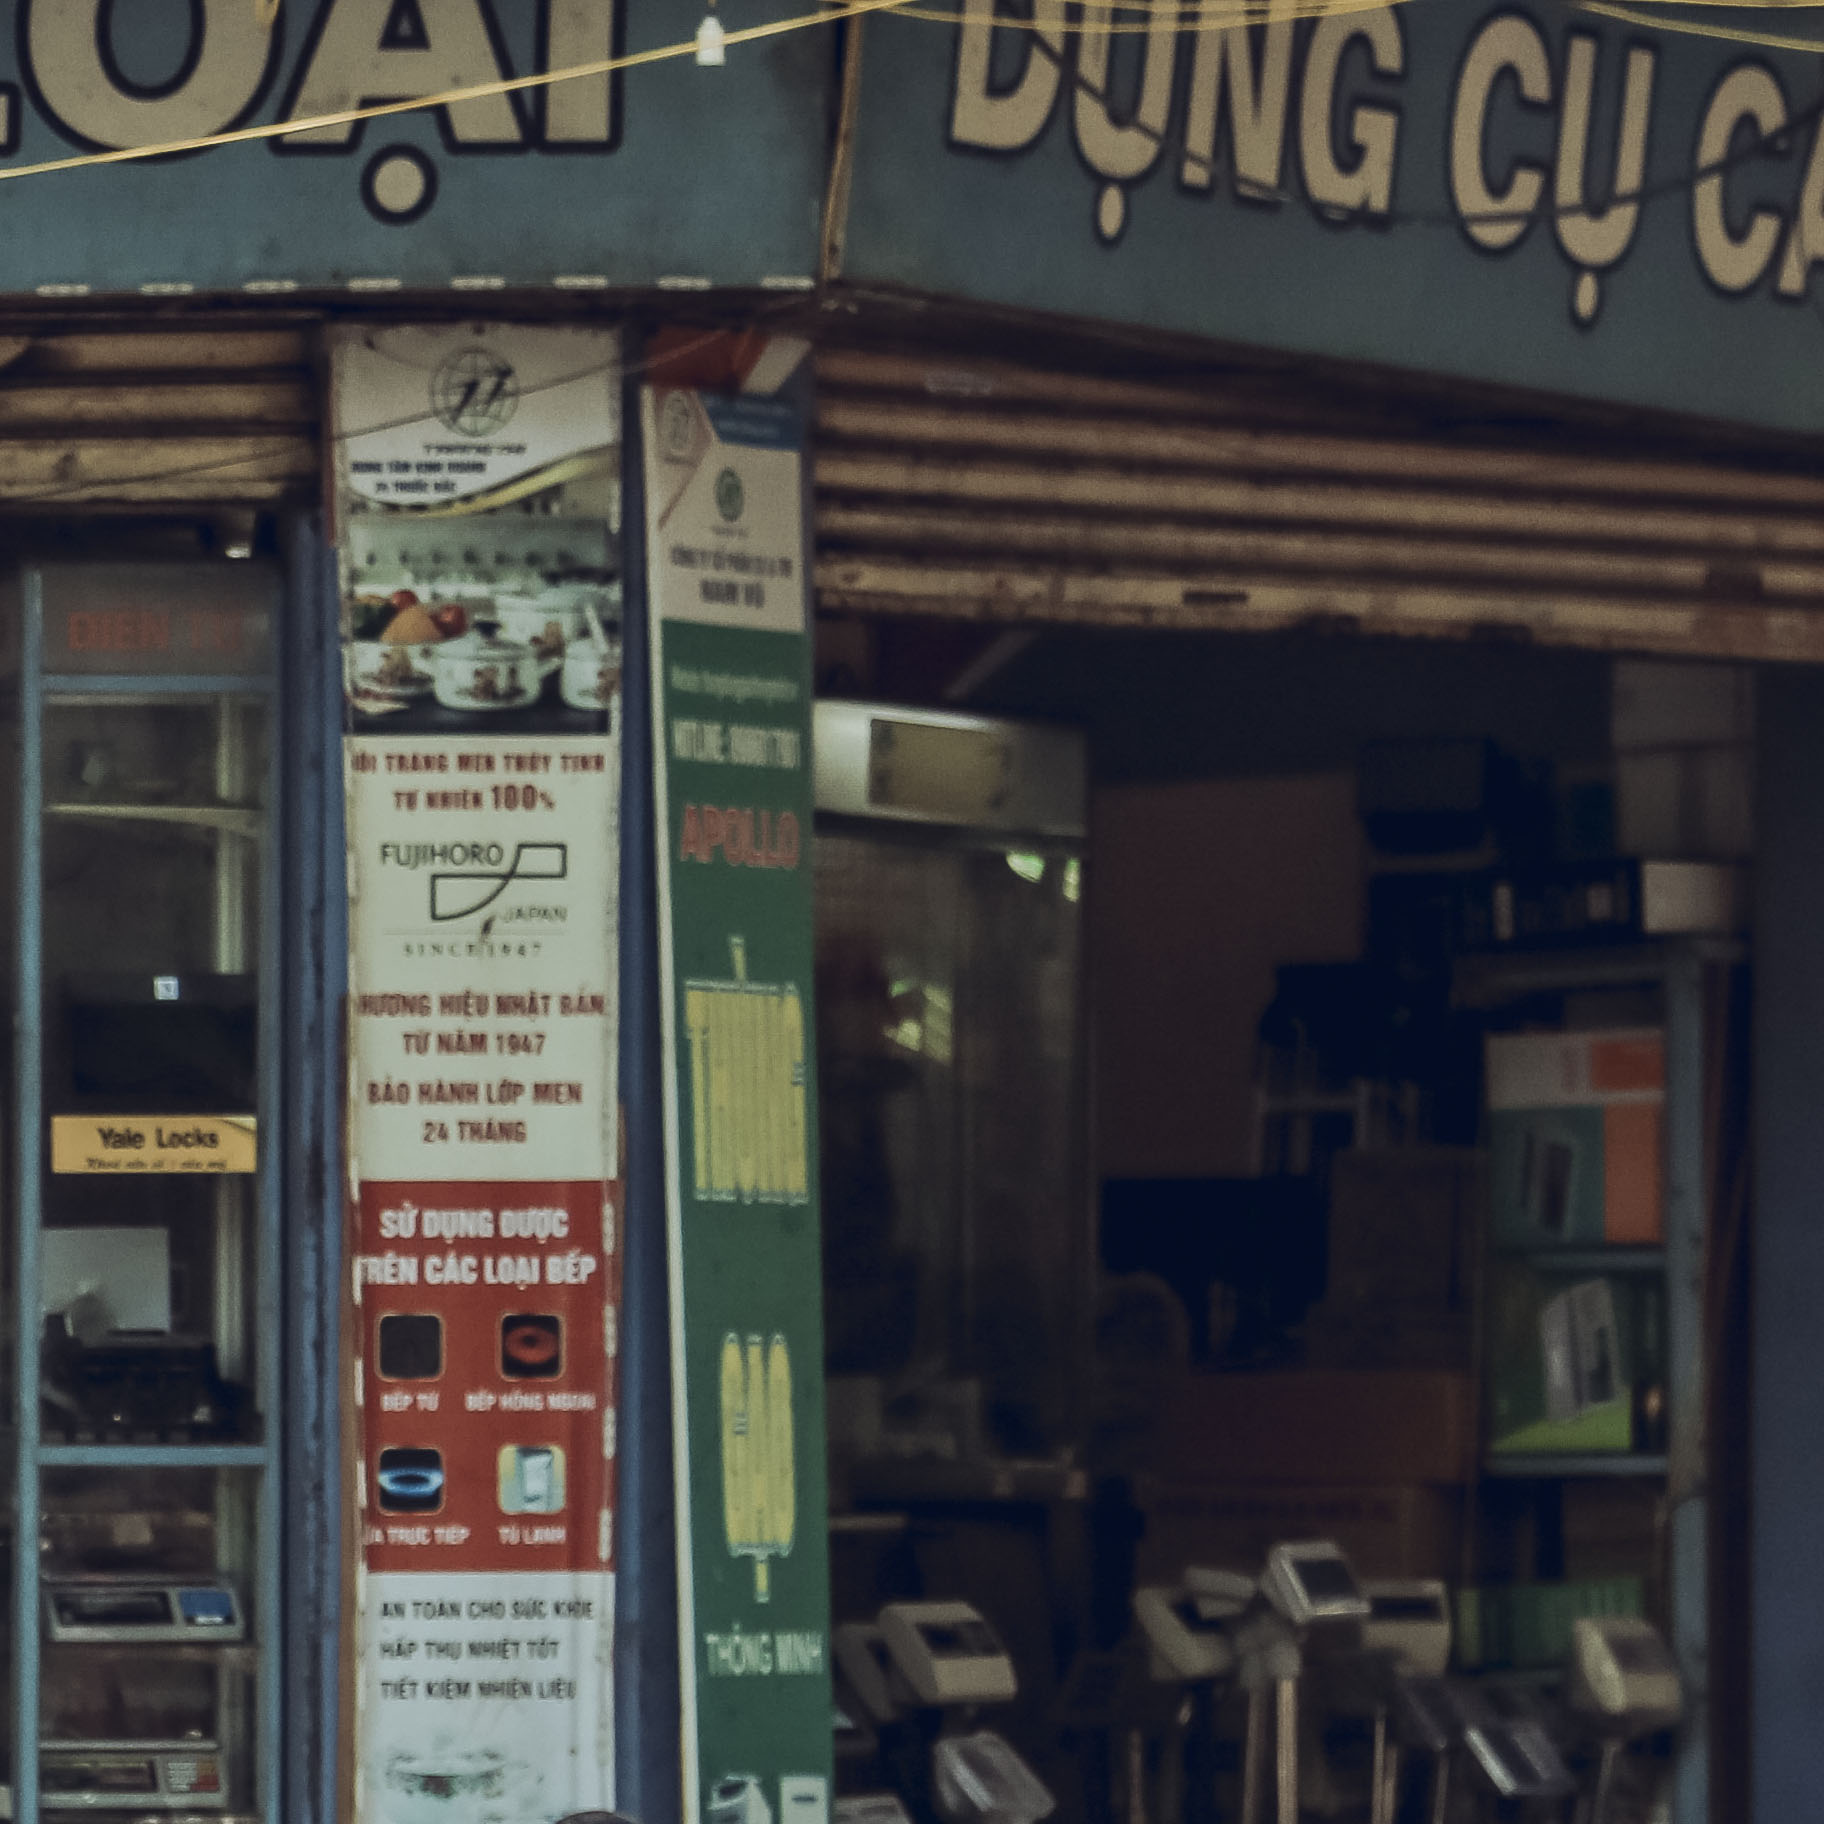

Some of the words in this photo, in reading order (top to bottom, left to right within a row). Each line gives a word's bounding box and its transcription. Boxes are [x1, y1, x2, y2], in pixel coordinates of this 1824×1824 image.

[1445, 12, 1656, 328] CỤ
[491, 784, 556, 812] 100%
[680, 802, 801, 870] APOLLO
[380, 843, 504, 871] FUJIHORO
[424, 1250, 478, 1286] CÁC
